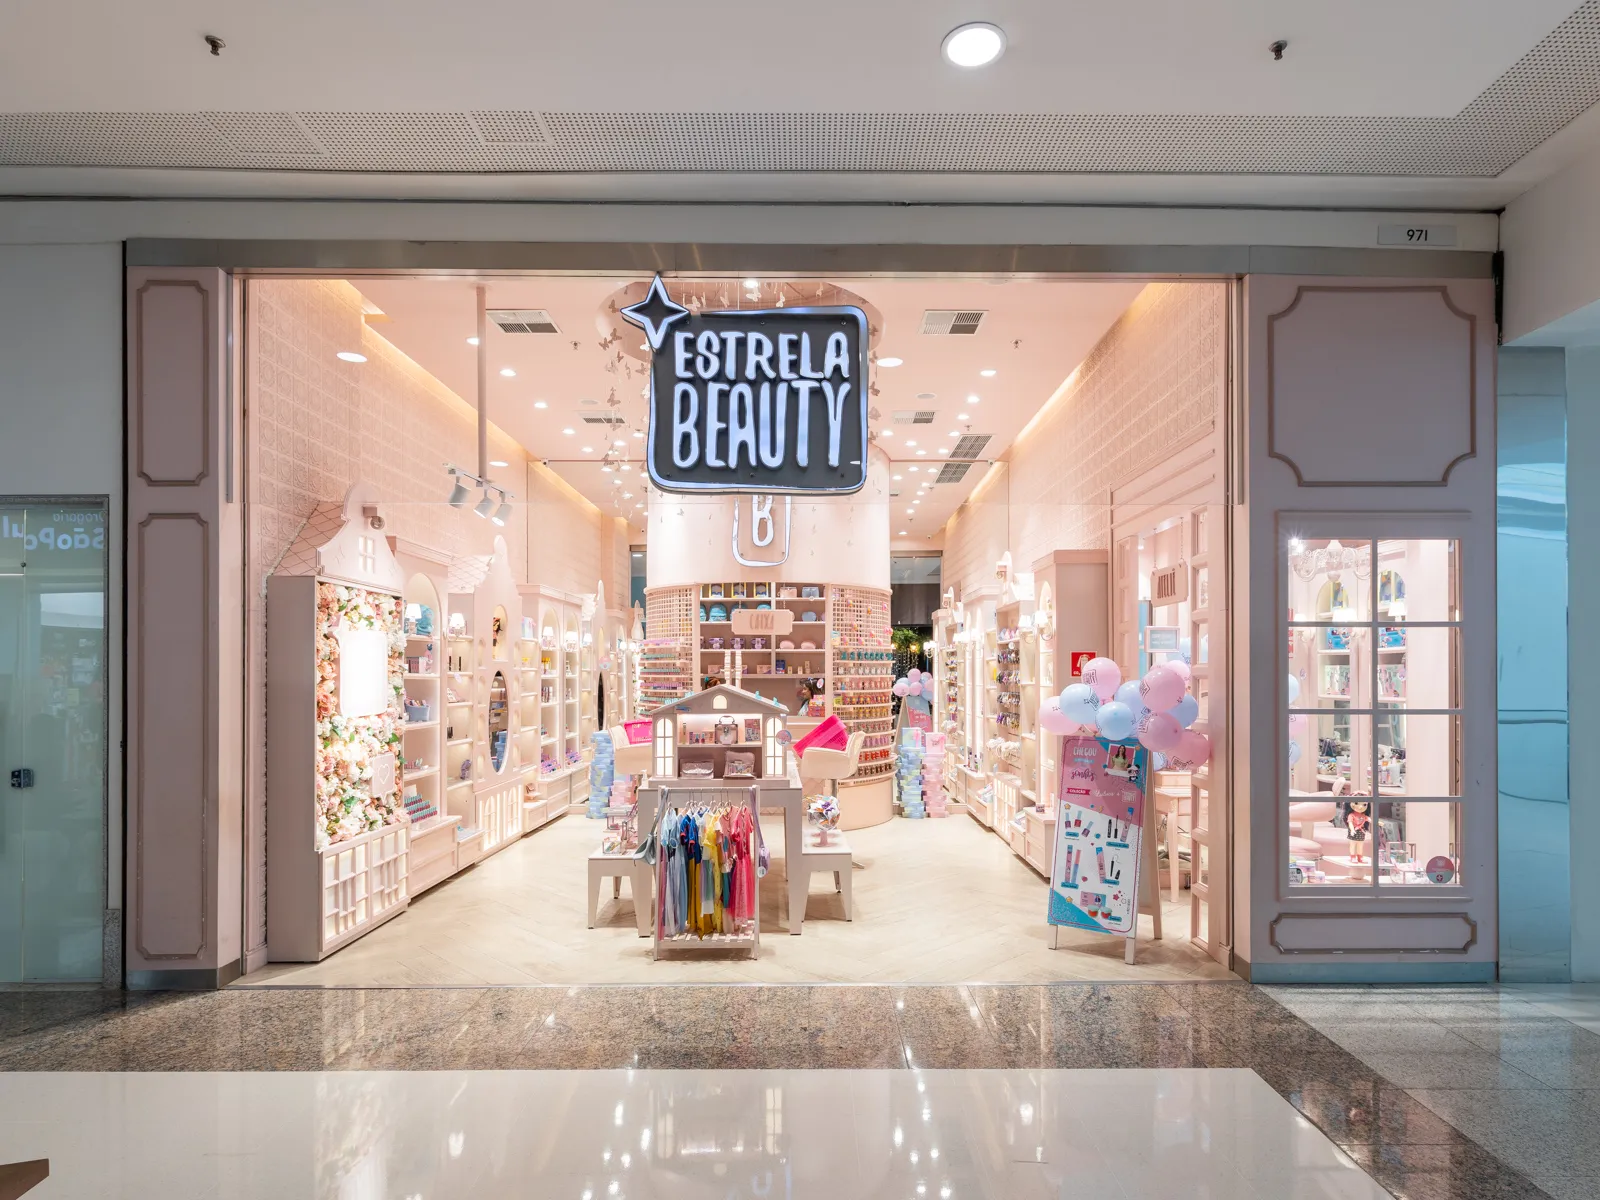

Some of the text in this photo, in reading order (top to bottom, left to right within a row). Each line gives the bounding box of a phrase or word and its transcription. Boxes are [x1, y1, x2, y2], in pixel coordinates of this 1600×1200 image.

[1406, 228, 1428, 241] 971
[674, 330, 851, 381] ESTRELA
[672, 379, 852, 470] BEAUTY
[749, 613, 774, 630] CAIXA
